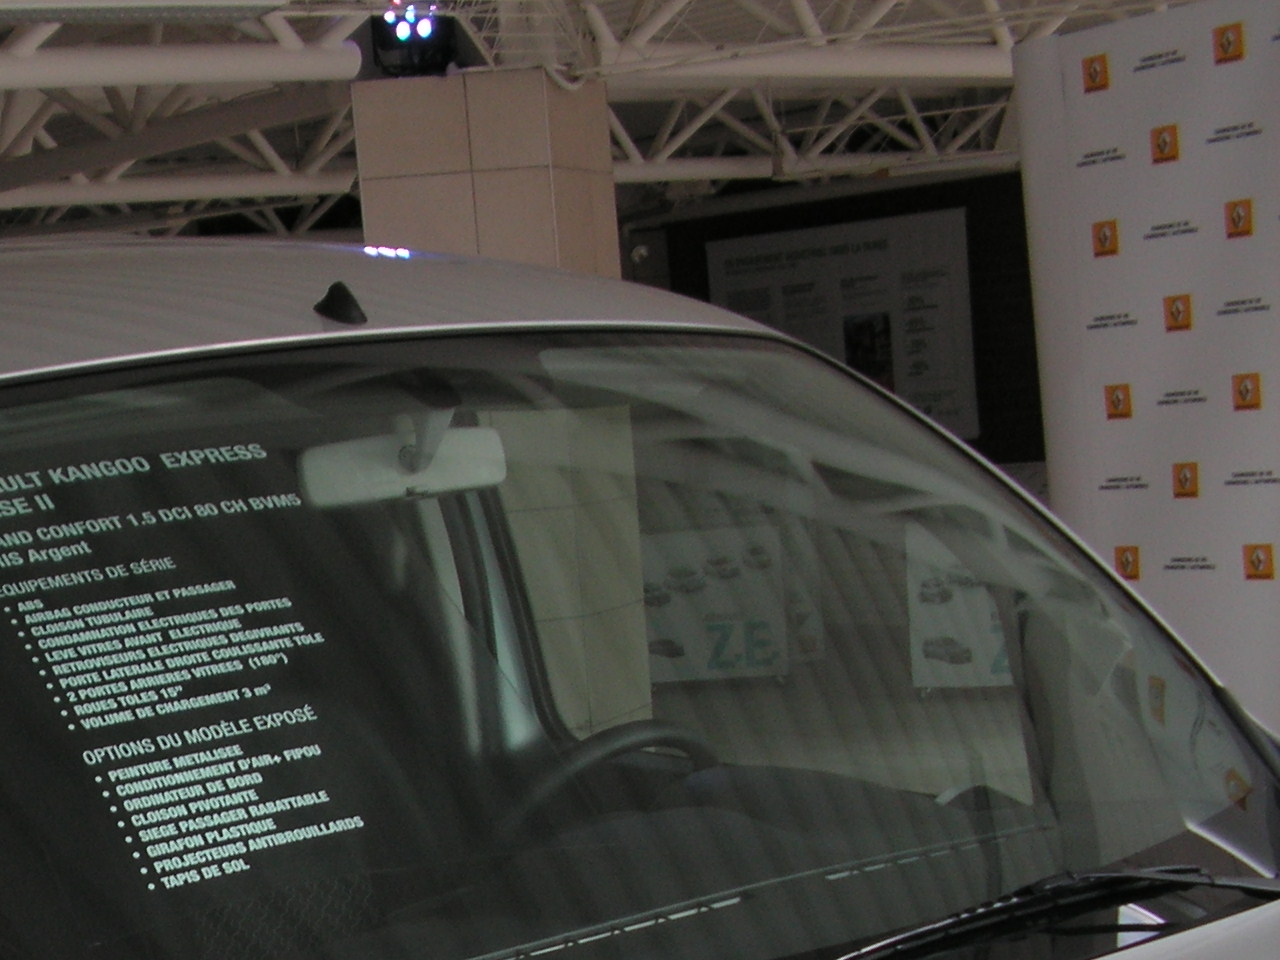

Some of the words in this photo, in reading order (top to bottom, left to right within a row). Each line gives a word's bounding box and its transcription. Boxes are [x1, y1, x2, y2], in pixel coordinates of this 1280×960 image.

[47, 456, 150, 486] KANGOO
[160, 442, 268, 470] EXPRESS
[35, 493, 56, 512] II
[36, 516, 122, 542] CONFORT
[126, 511, 157, 529] 1.5
[158, 506, 192, 524] DCI
[194, 502, 218, 518] 80
[220, 498, 247, 515] CH
[247, 493, 302, 512] BVM5
[28, 540, 92, 566] Argent
[105, 564, 129, 579] DE
[130, 557, 176, 574] SÉRIE
[18, 599, 44, 612] ABS
[25, 607, 72, 624] AIRBAG
[73, 593, 154, 616] CONDUCTEUR
[154, 589, 171, 602] ET
[172, 579, 236, 599] PASSAGER
[31, 618, 85, 637] CLOISON
[85, 606, 154, 627] TUBULAIRE
[38, 623, 136, 649] CONDAMNATION
[138, 608, 218, 631] ELECTRIQUES
[219, 604, 244, 617] DES
[245, 597, 292, 613] PORTES
[44, 647, 77, 663] LEVE
[77, 639, 122, 656] VITRES
[124, 632, 163, 648] AVANT
[169, 618, 242, 640] ELECTRIQUE
[52, 649, 146, 676] RETROVISEURS
[147, 634, 228, 658] ELECTRIQUES
[229, 622, 305, 643] DEGIVRANTS
[59, 672, 102, 689] PORTE
[102, 660, 165, 681] LATERALE
[165, 652, 211, 669] DROITE
[212, 638, 294, 660] COULISSANTE
[293, 632, 325, 647] TOLE
[66, 691, 78, 702] 2
[78, 681, 128, 700] PORTES
[129, 669, 191, 690] ARRIERES
[191, 660, 243, 678] VITREES
[74, 698, 117, 716] ROUES
[117, 690, 159, 707] TOLES
[80, 710, 135, 730] VOLUME
[135, 706, 155, 720] DE
[156, 689, 240, 715] CHARGEMENT
[241, 687, 253, 698] 3
[83, 738, 155, 765] OPTIONS
[156, 733, 182, 750] DU
[184, 719, 253, 745] MODÈLE
[253, 704, 318, 730] EXPOSÉ
[108, 759, 172, 782] PEINTURE
[172, 744, 244, 769] METALISEE
[116, 762, 236, 797] CONDITIONNEMENT
[123, 784, 206, 812] ORDINATEUR
[206, 779, 226, 792] DE
[226, 772, 263, 789] BORD
[131, 804, 188, 827] CLOISON
[188, 789, 259, 814] PIVOTANTE
[138, 823, 179, 842] SIEGE
[179, 808, 248, 832] PASSAGER
[248, 790, 330, 818] RABATTABLE
[146, 834, 205, 858] GIRAFON
[205, 818, 277, 844] PLASTIQUE
[153, 841, 247, 874] PROJECTEURS
[248, 815, 364, 851] ANTIBROUILLARDS
[160, 869, 200, 889] TAPIS
[201, 864, 222, 879] DE
[222, 858, 250, 874] SOL
